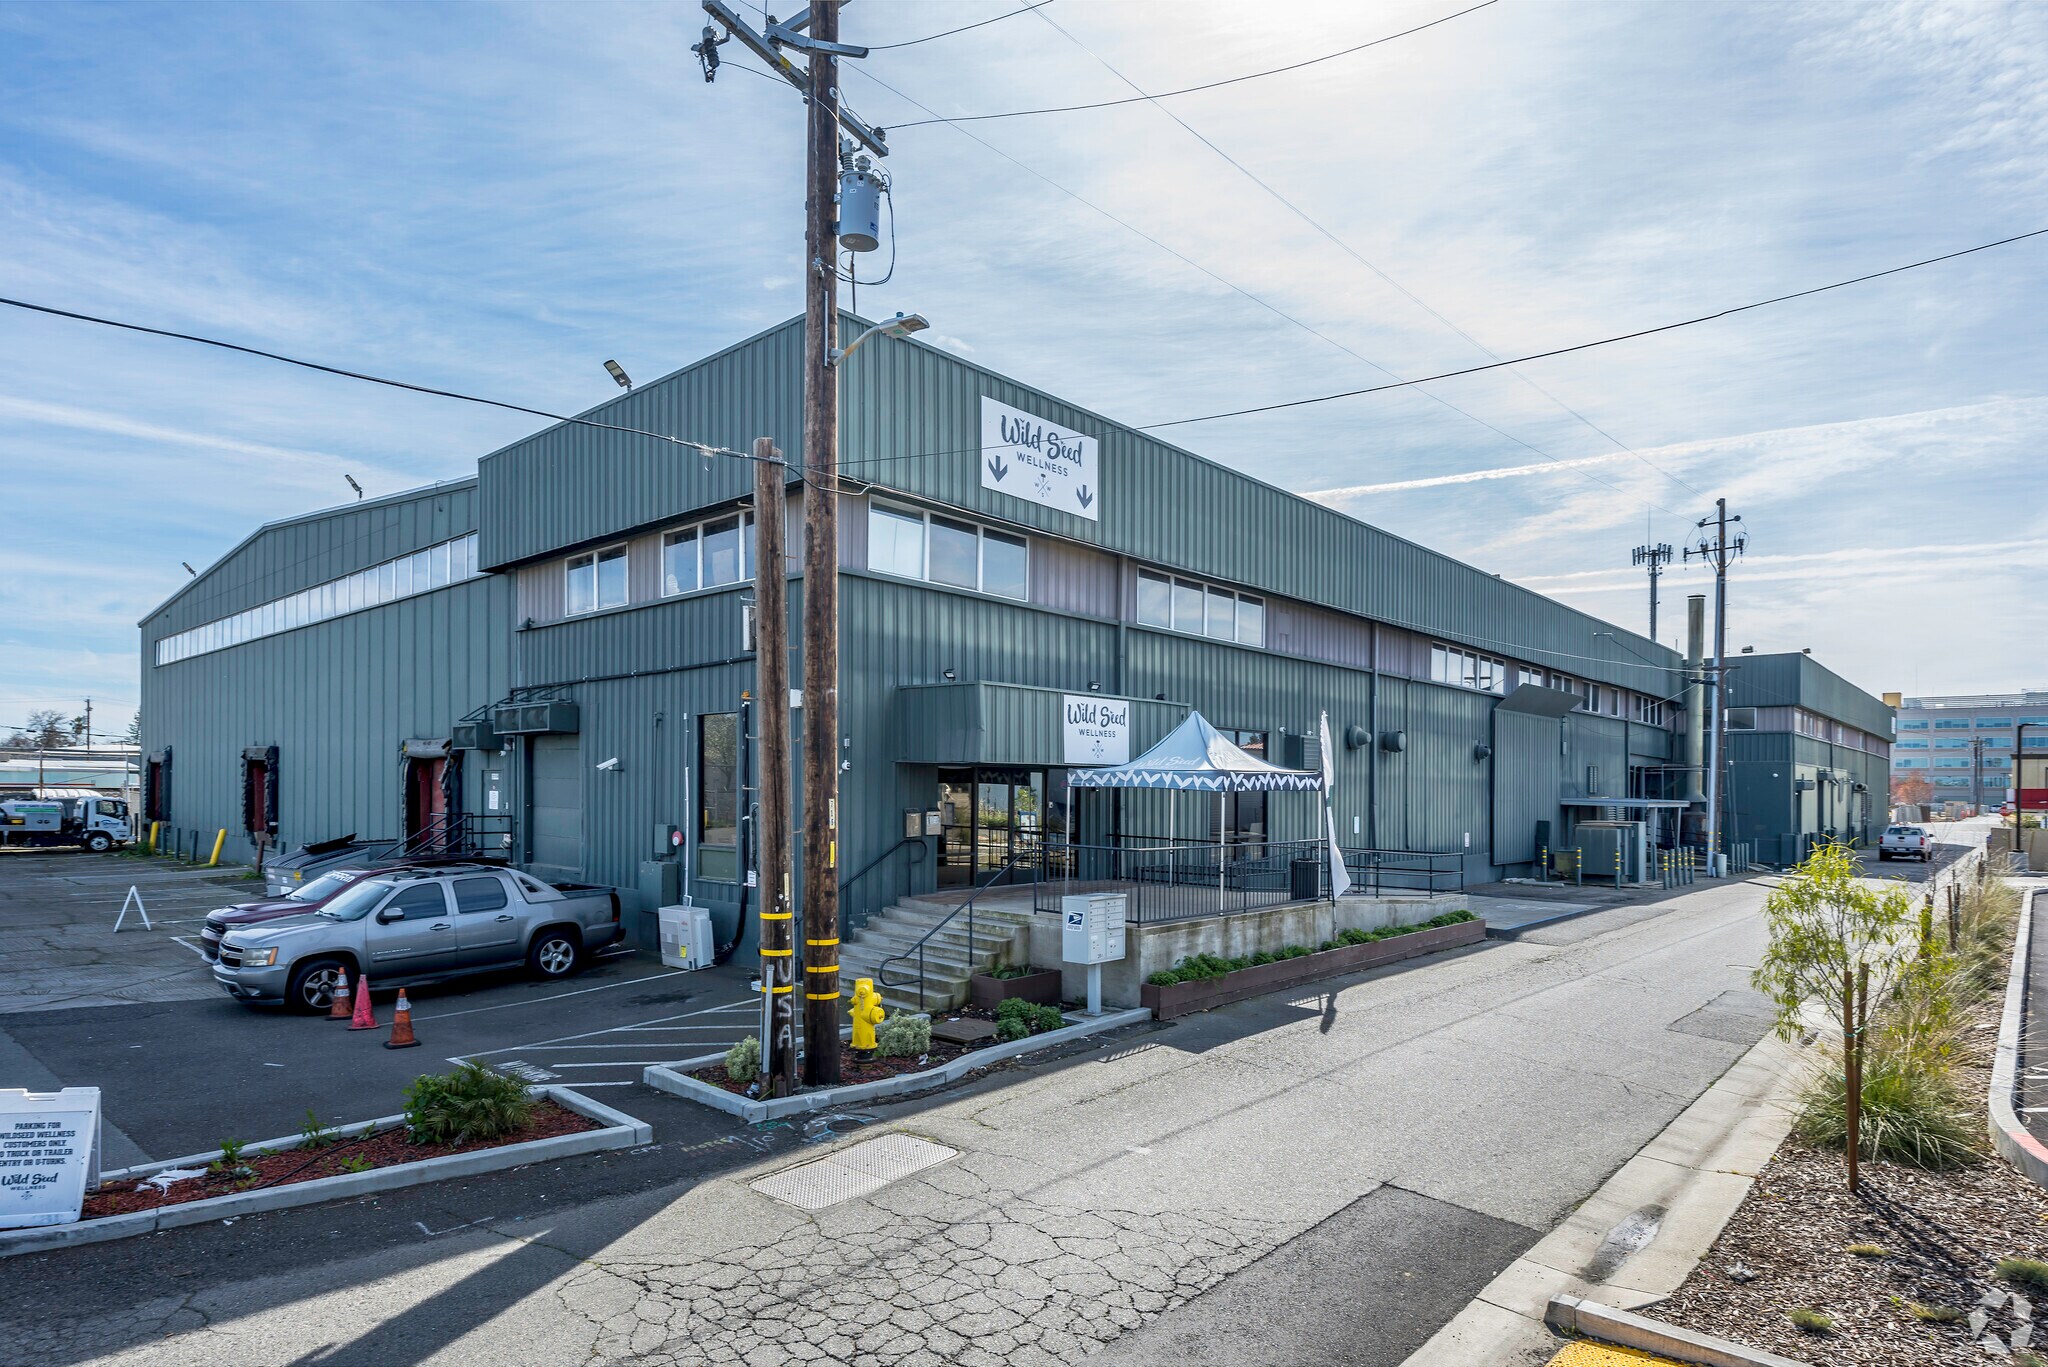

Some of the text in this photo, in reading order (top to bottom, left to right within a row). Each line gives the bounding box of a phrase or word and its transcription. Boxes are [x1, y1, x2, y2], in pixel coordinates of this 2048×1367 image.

[1001, 414, 1082, 467] Wild Seed
[1016, 451, 1069, 477] WELLNESS
[1067, 703, 1127, 728] Wild Seed
[1078, 728, 1117, 738] WELLNESS
[1, 1173, 59, 1186] Wild Seed
